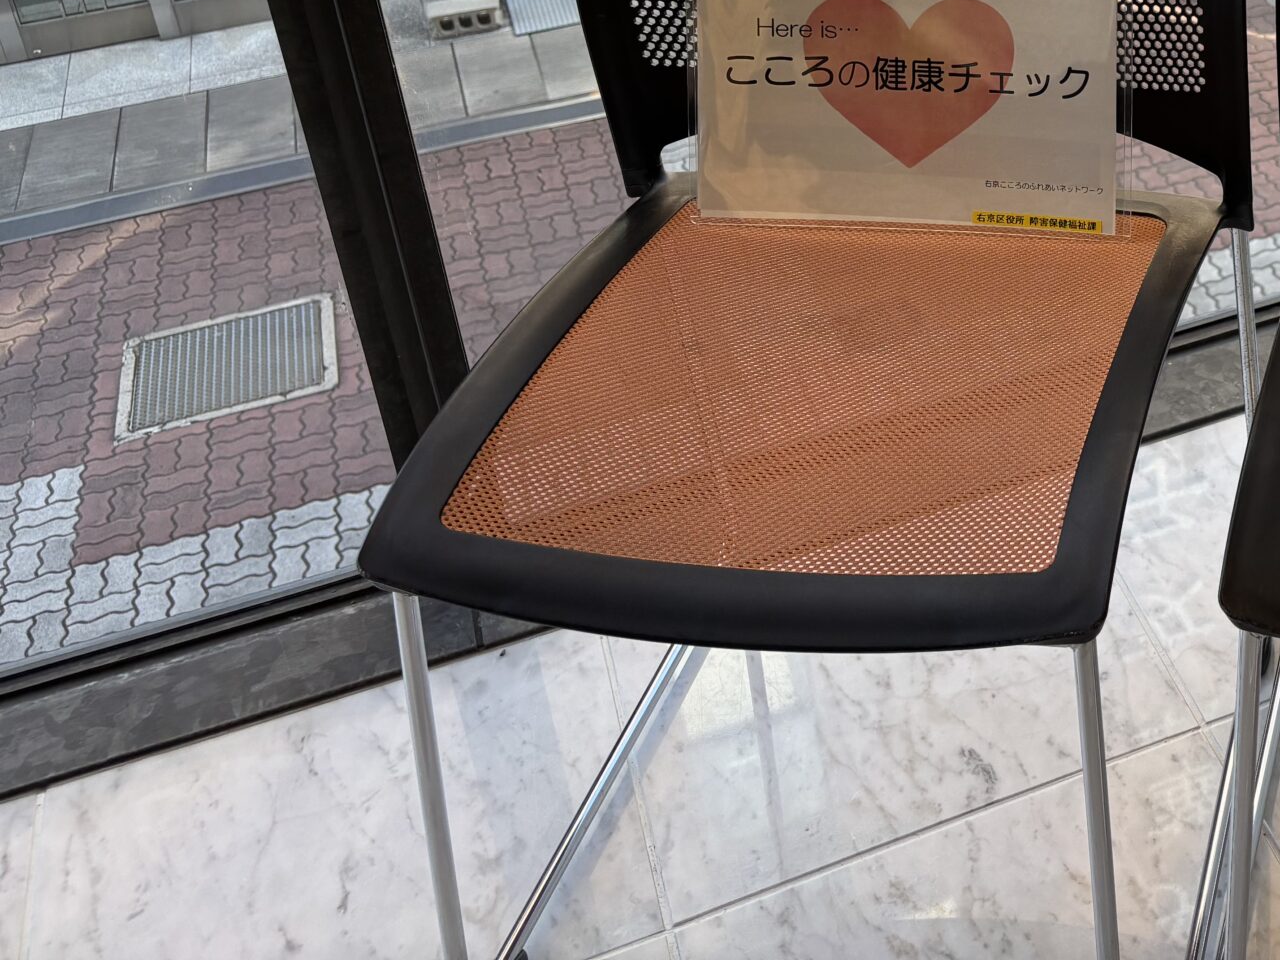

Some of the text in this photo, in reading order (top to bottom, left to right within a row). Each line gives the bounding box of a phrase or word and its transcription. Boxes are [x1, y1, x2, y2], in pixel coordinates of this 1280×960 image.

[757, 17, 812, 38] Here
[726, 55, 1090, 100] こころの健康チェック
[984, 179, 1104, 195] 右京こころのふれあいネットワーク
[976, 213, 1097, 231] 右京区役所 障害保健福祉課
